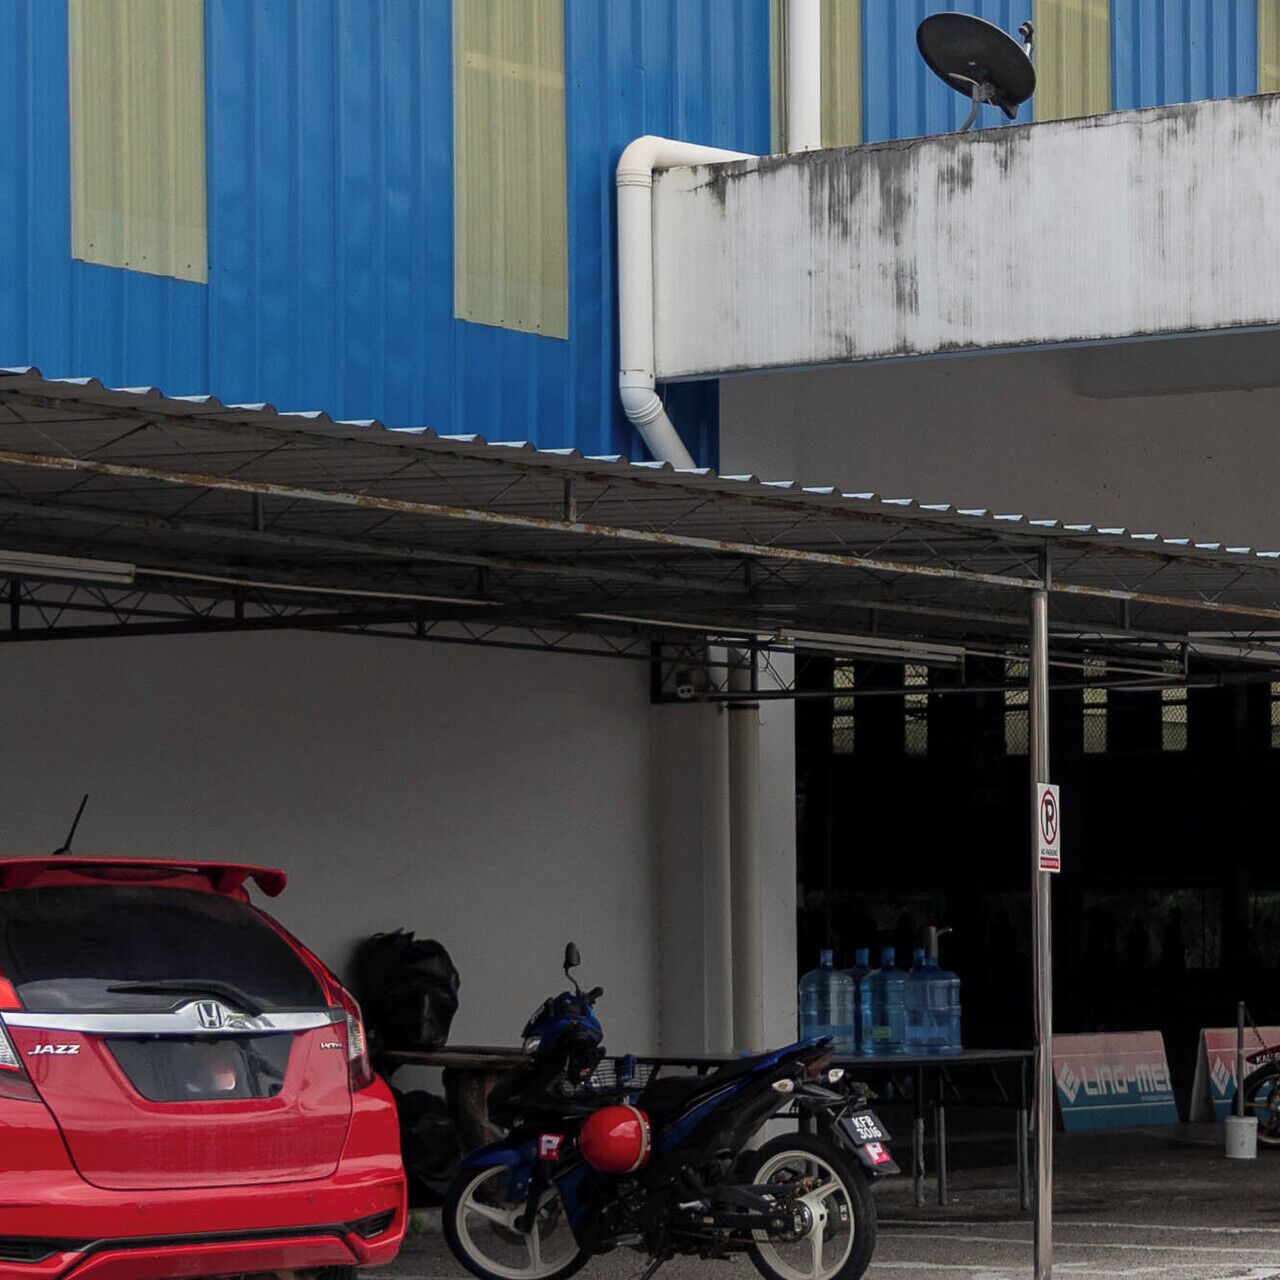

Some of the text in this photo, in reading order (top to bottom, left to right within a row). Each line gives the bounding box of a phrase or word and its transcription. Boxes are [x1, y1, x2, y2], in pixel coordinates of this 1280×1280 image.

[28, 1043, 81, 1056] JAZZ
[851, 1115, 875, 1129] KFB
[857, 1126, 883, 1140] 3016
